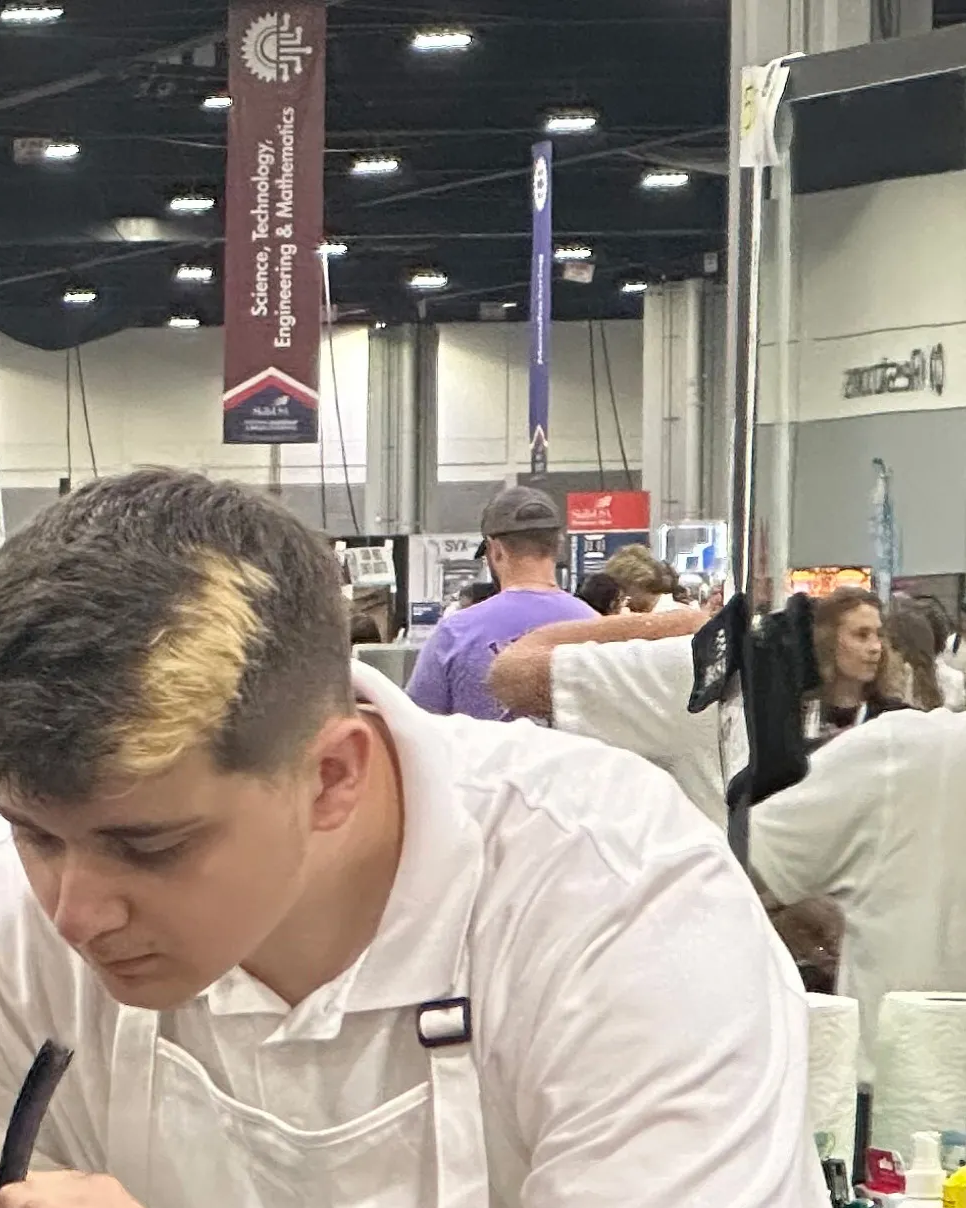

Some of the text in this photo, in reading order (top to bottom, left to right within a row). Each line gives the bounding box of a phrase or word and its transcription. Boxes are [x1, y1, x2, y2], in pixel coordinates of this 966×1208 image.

[250, 139, 275, 316] Science, Technology,
[274, 106, 297, 348] Engineering & Mathematics
